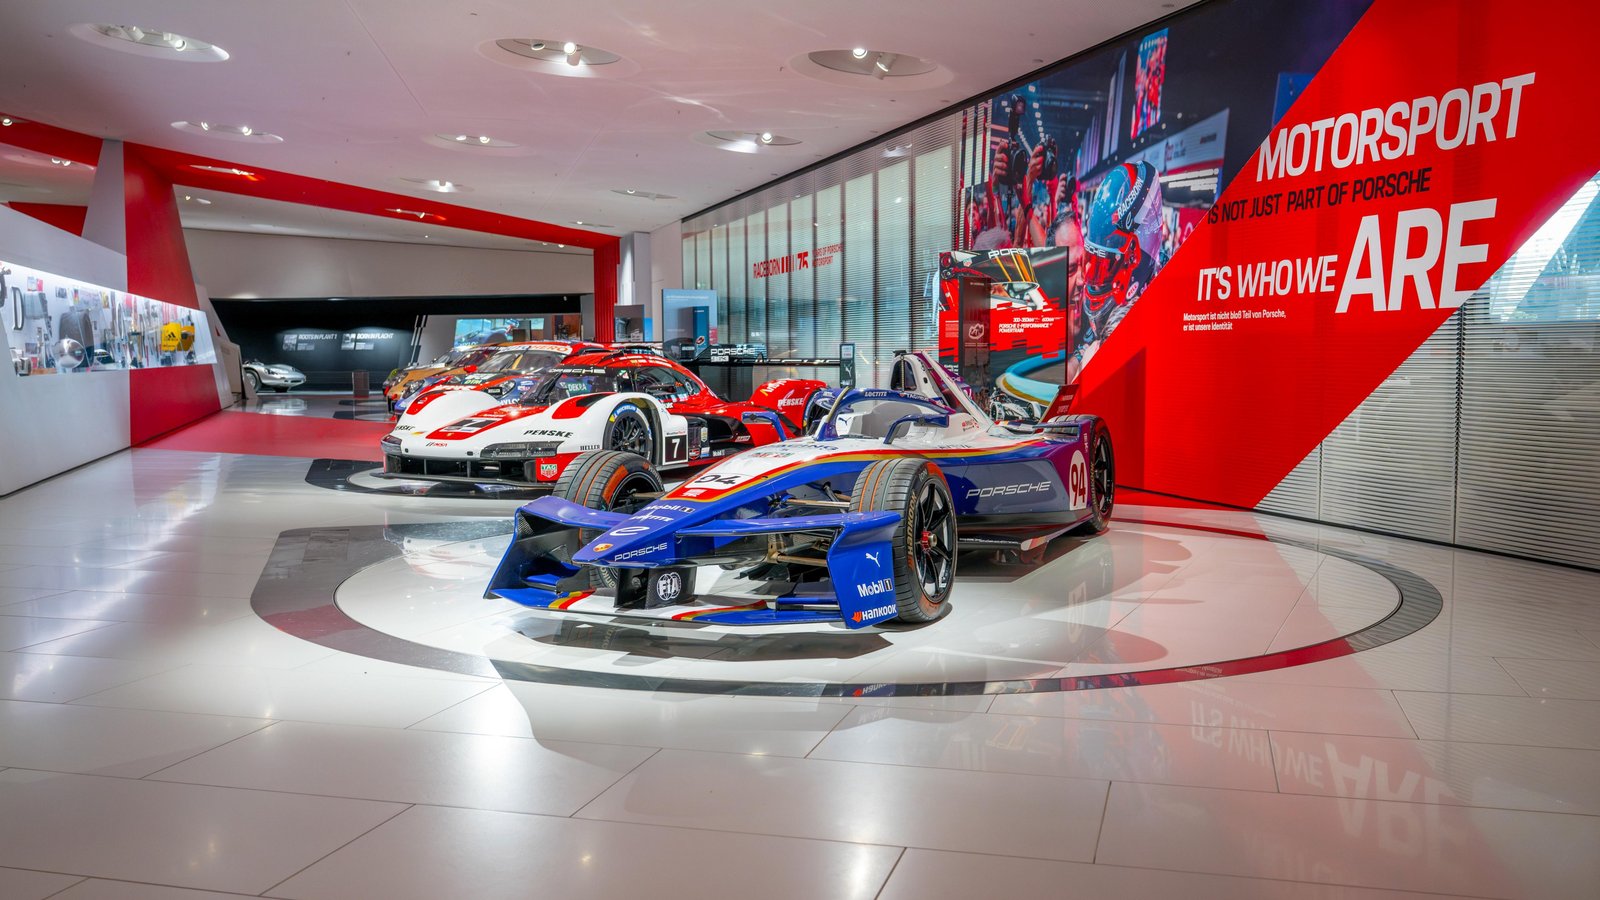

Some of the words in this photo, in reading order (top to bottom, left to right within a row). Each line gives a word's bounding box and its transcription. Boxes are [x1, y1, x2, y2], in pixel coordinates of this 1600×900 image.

[1256, 72, 1536, 182] MOTORSPORT
[1117, 176, 1145, 220] RACEBORN
[1207, 204, 1220, 225] IS
[1221, 200, 1249, 222] NOT
[1249, 193, 1282, 219] JUST
[1287, 185, 1326, 213] PART
[1327, 182, 1349, 206] OF
[1352, 167, 1433, 201] PORSCHE
[753, 258, 780, 279] RACEBORN
[797, 251, 809, 270] 75
[1197, 265, 1232, 301] IT'S
[1237, 258, 1294, 298] WHO
[1295, 254, 1338, 294] WE
[1334, 197, 1498, 314] ARE
[1183, 311, 1210, 322] Motorsport
[1217, 310, 1230, 320] nicht
[1230, 310, 1242, 319] bloß
[1242, 310, 1251, 319] Teil
[1252, 311, 1262, 319] von
[1262, 308, 1287, 319] Porsche,
[1195, 323, 1211, 331] unsere
[1211, 321, 1233, 331] Identität
[567, 383, 588, 392] DEKRA
[523, 429, 574, 439] PENSKE
[671, 438, 681, 459] 7
[694, 473, 740, 485] 94
[1070, 462, 1086, 507] 94
[966, 480, 1052, 500] PORSCHE
[614, 543, 668, 562] PORSCHE
[659, 576, 680, 597] FIA
[857, 582, 885, 598] Mobil
[884, 577, 894, 592] 1
